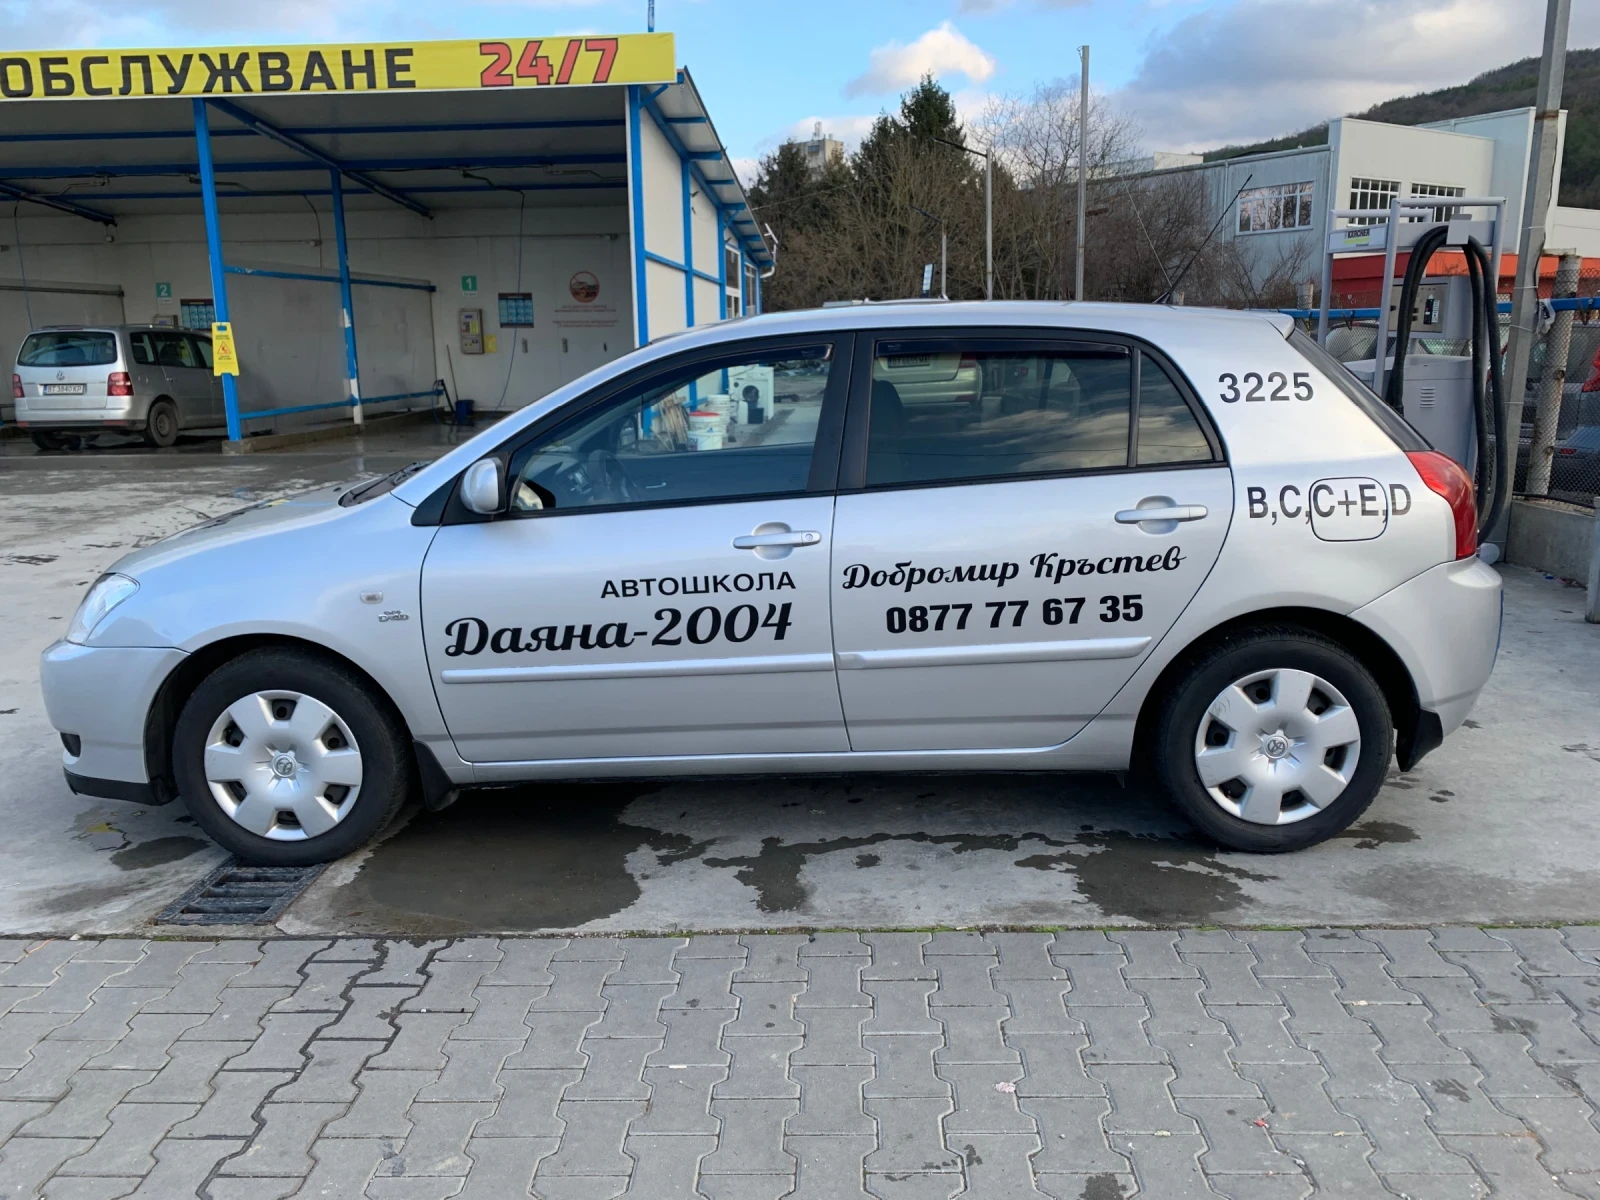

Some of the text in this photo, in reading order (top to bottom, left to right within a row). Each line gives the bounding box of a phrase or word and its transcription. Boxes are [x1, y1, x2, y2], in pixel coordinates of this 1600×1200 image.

[0, 37, 619, 98] ОБСЛУЖВАНЕ 24/7
[160, 284, 168, 297] 2
[1218, 371, 1314, 404] 3225
[600, 571, 797, 600] АВТОШКОЛА
[842, 545, 1187, 593] Добромир Кръстев
[445, 602, 793, 657] Даяна-2004
[886, 594, 1144, 635] 0877 77 67 35
